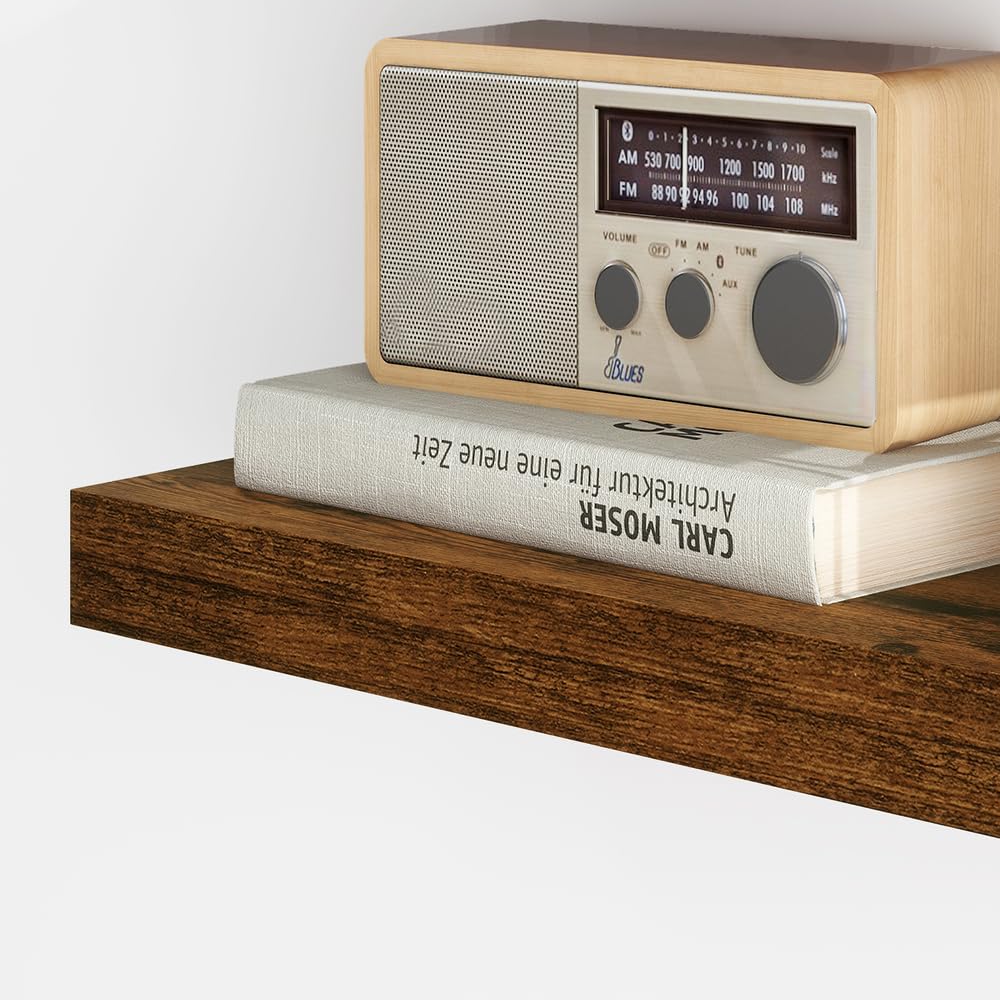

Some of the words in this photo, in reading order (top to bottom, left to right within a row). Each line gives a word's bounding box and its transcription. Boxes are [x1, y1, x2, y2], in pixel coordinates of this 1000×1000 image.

[796, 143, 806, 155] 10
[618, 149, 638, 165] AM
[644, 151, 662, 168] 530
[664, 153, 682, 170] 700
[687, 155, 705, 172] 900
[719, 158, 742, 176] 1200
[752, 161, 775, 179] 1500
[781, 163, 805, 182] 1700
[821, 171, 838, 185] kHz
[619, 181, 637, 198] FM
[651, 184, 664, 201] 88
[665, 186, 677, 202] 90
[692, 188, 705, 205] 94
[706, 189, 719, 207] 96
[731, 192, 749, 210] 100
[757, 194, 775, 212] 104
[785, 197, 804, 215] 108
[821, 203, 839, 217] MHz
[603, 231, 638, 244] VOLUME
[651, 245, 667, 256] OFF
[675, 239, 688, 249] FM
[696, 241, 710, 251] AM
[735, 246, 758, 257] TUNE
[722, 279, 738, 289] AUX
[412, 434, 453, 469] Zeit
[459, 442, 510, 471] neue
[517, 452, 562, 488] eine
[569, 463, 601, 498] für
[609, 471, 736, 523] Architektur
[578, 500, 661, 545] MOSER
[671, 518, 734, 559] CARL
